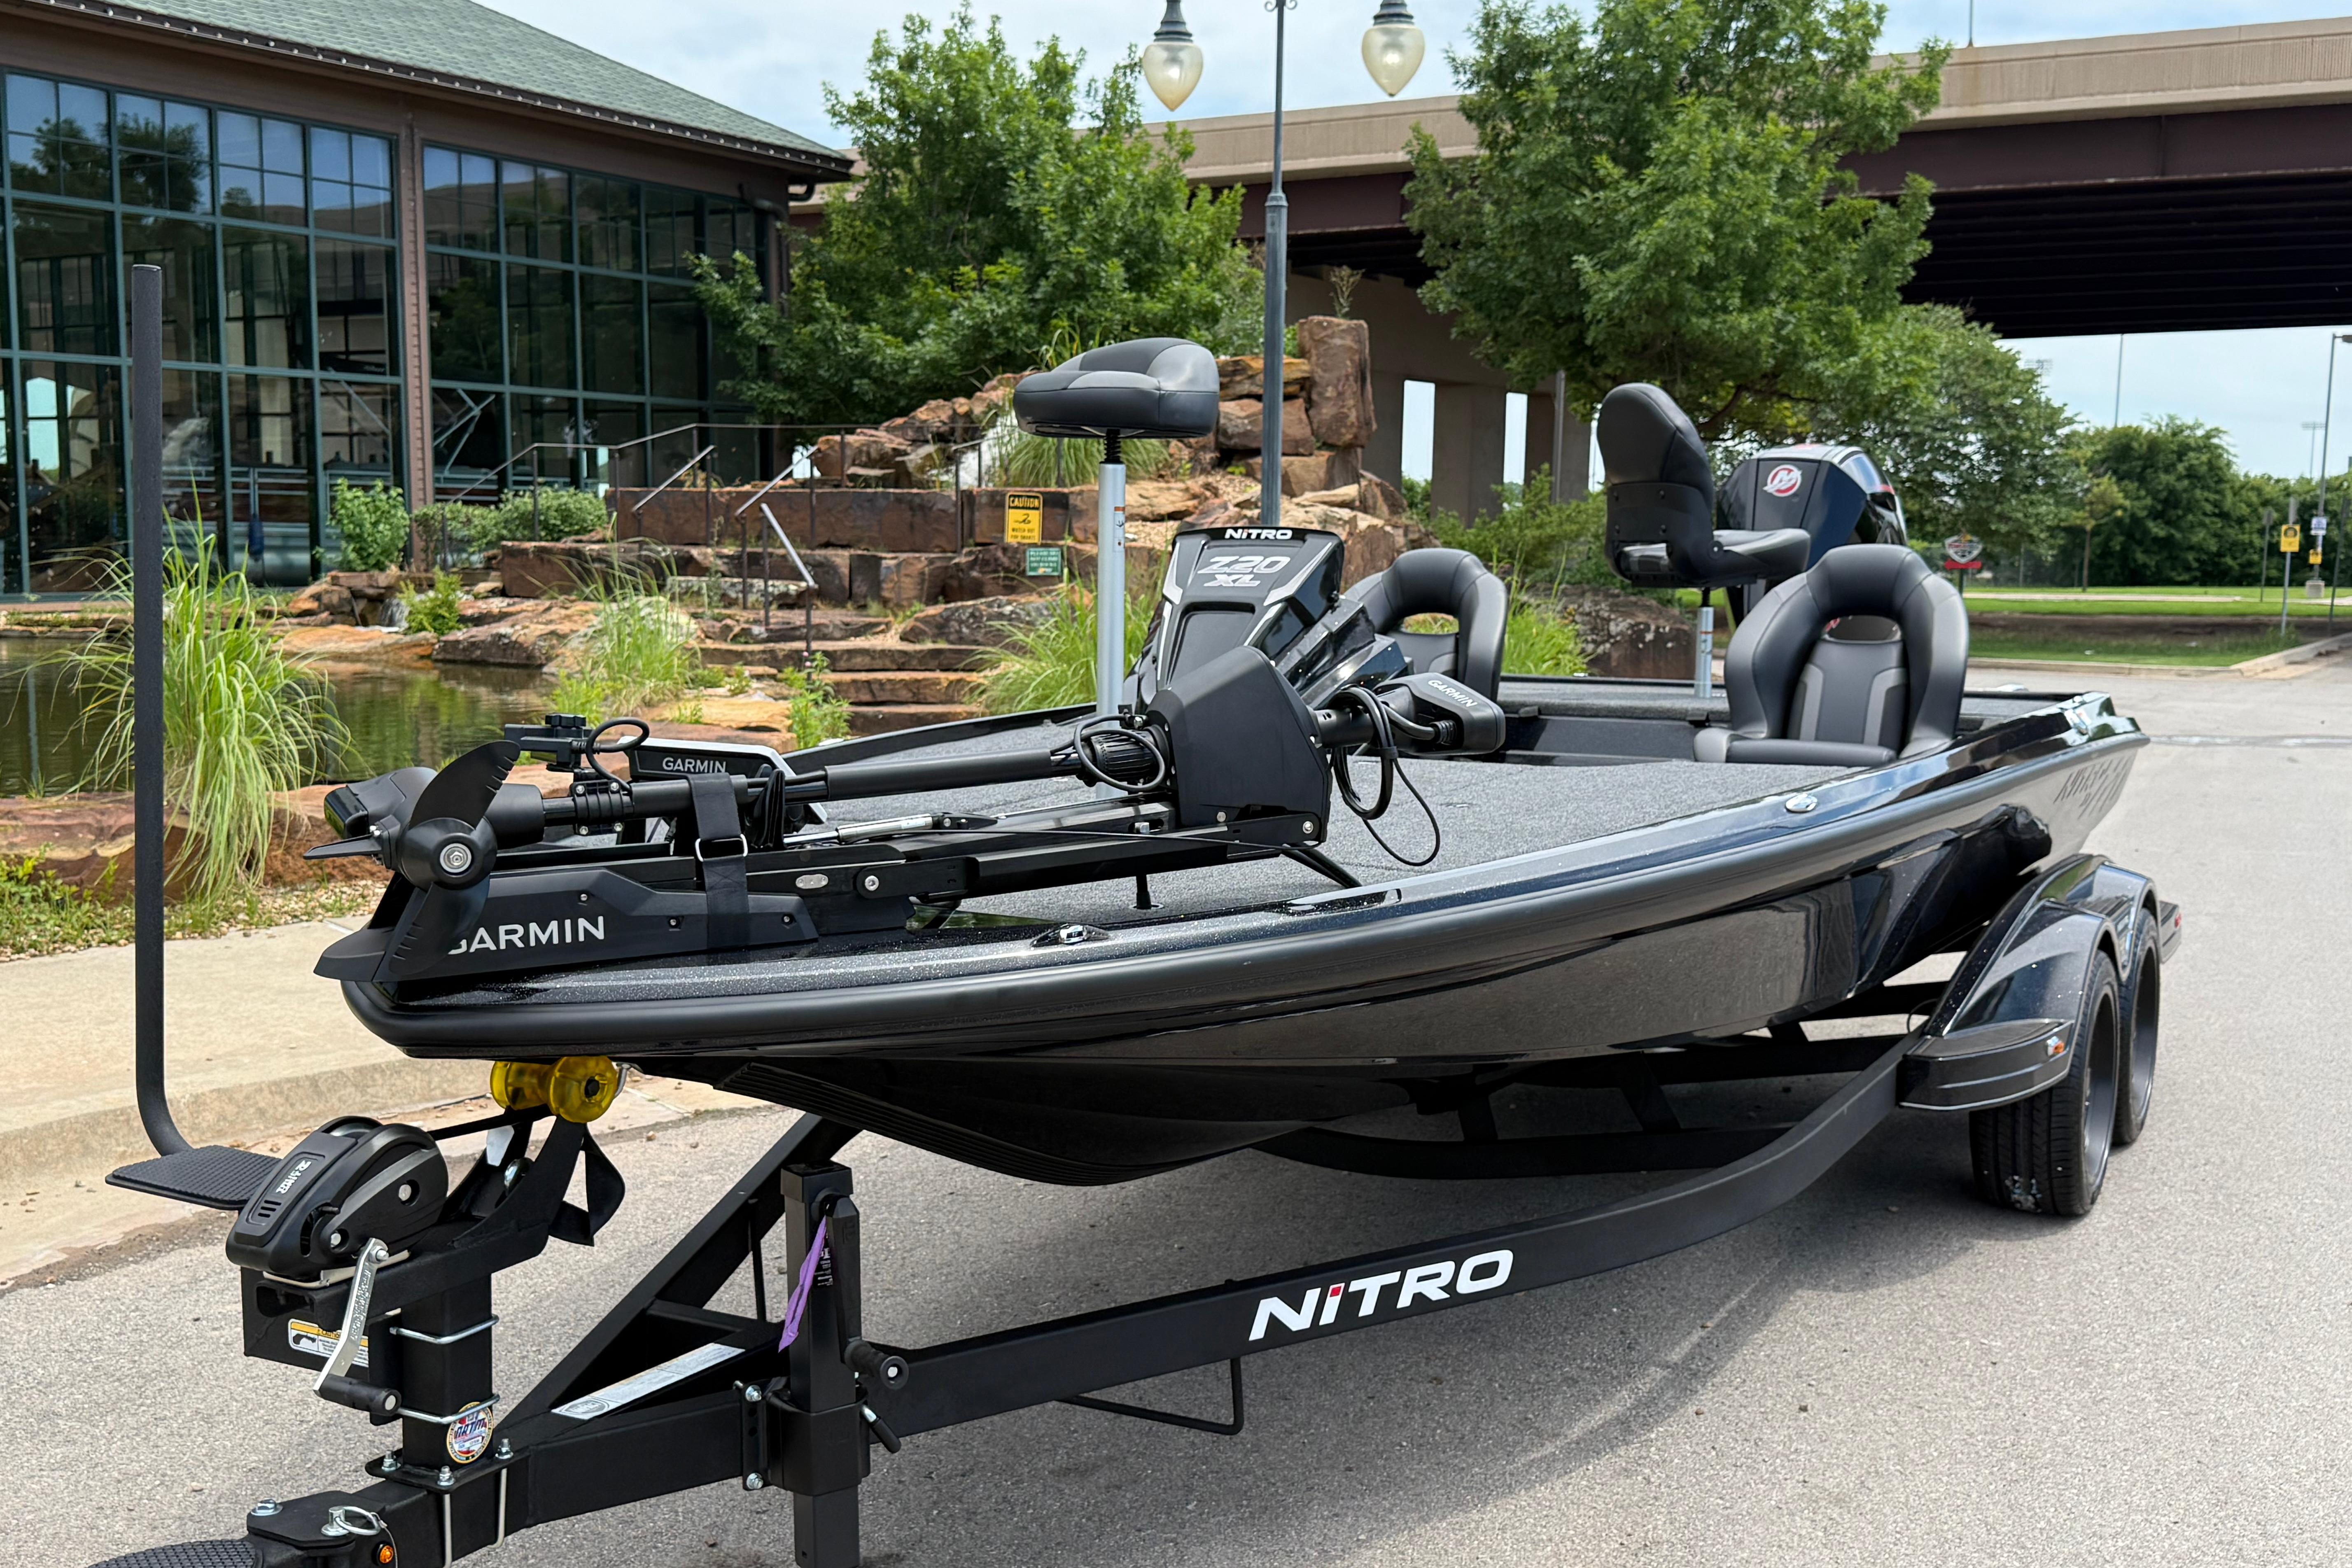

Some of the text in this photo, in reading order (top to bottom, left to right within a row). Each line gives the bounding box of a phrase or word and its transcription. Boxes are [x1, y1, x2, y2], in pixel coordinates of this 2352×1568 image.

[1010, 497, 1040, 508] CAUTION
[1225, 529, 1292, 540] NITRO
[1197, 556, 1290, 574] Z20
[1204, 574, 1260, 587] XL
[1428, 680, 1477, 707] GARMIN
[662, 757, 726, 773] GARMIN
[1248, 1250, 1513, 1341] NITRO
